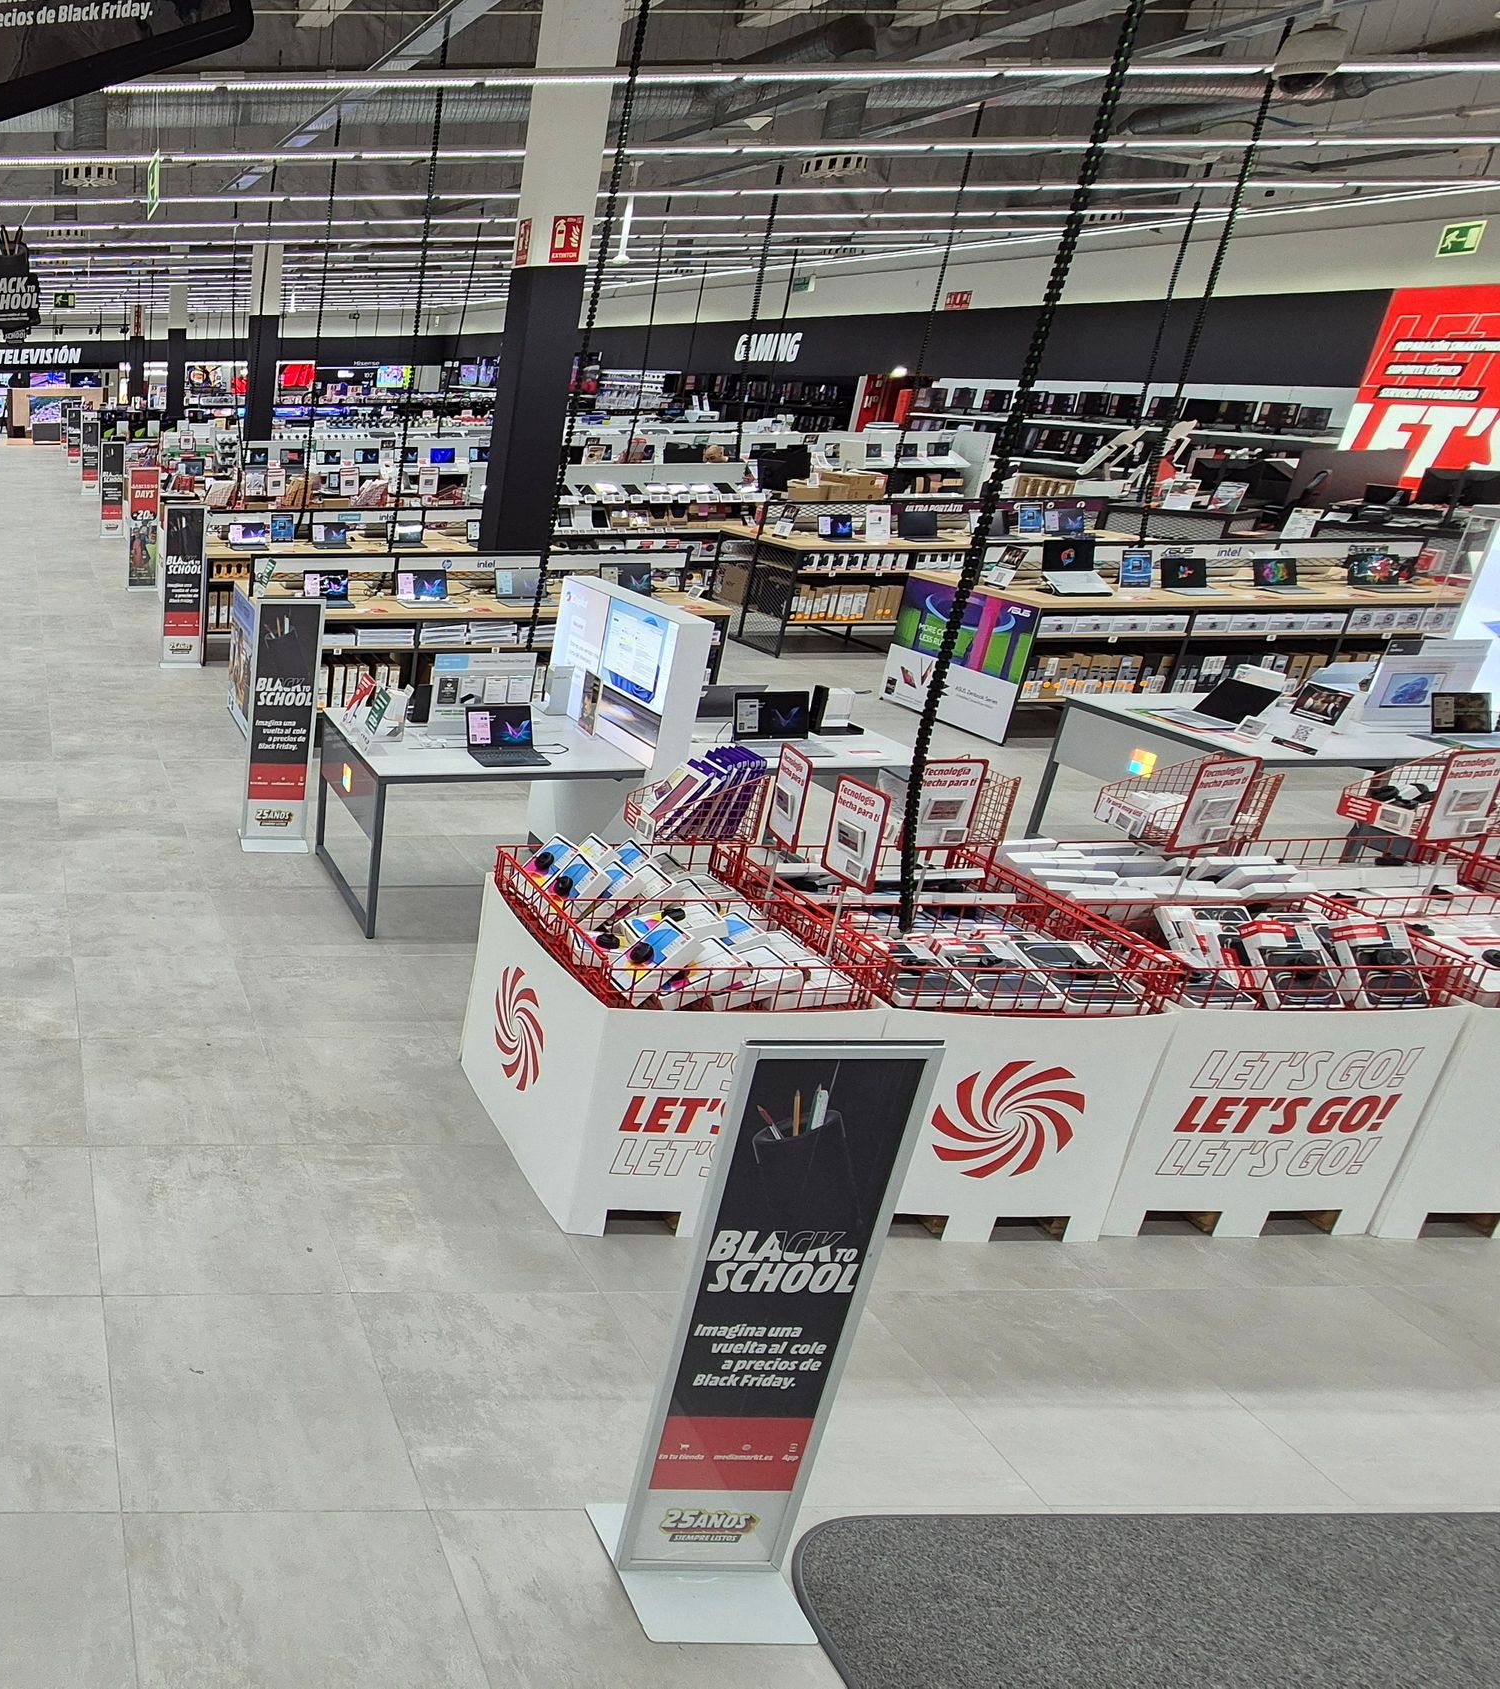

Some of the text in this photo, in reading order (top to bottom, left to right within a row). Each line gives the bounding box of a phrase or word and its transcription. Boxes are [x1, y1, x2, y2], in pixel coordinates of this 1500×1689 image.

[36, 8, 56, 25] de
[57, 4, 100, 24] Black
[101, 0, 154, 21] Friday.
[550, 251, 579, 260] EXTINTOR
[734, 332, 804, 363] GAMING
[135, 489, 155, 500] DAYS
[932, 500, 964, 513] PORTÁTIL
[1162, 547, 1195, 555] ASUS
[1217, 547, 1242, 557] intel
[166, 555, 195, 566] BLACK
[477, 560, 497, 569] intel
[168, 564, 202, 576] SCHOOL
[1007, 606, 1032, 618] ASUS
[256, 677, 312, 693] BLACK TO
[257, 690, 312, 707] SCHOOL
[255, 719, 282, 728] Imagina
[262, 727, 307, 736] vuelta al cole
[272, 735, 298, 744] precios
[297, 735, 306, 743] de
[258, 742, 299, 751] Black Friday.
[924, 766, 972, 778] Tecnología
[1471, 769, 1490, 780] para
[947, 778, 971, 789] para
[1221, 778, 1241, 789] para
[840, 783, 877, 808] Tecnología
[837, 795, 874, 820] hecha para
[1189, 1046, 1427, 1091] LET'S GO!
[1172, 1093, 1404, 1135] LET'S GO!
[1154, 1135, 1383, 1178] LET'S GO!
[706, 1229, 859, 1263] BLACK TO
[706, 1262, 860, 1294] SCHOOL
[693, 1323, 803, 1340] Imagina una
[711, 1340, 828, 1355] vuelta al cole
[720, 1358, 822, 1373] a precios de
[692, 1373, 797, 1390] Black Friday.
[658, 1453, 669, 1461] En
[677, 1453, 705, 1462] tienda
[712, 1453, 774, 1462] mediamarkt.es
[781, 1454, 800, 1463] App
[672, 1533, 739, 1542] SIEMPRE LISTOS
